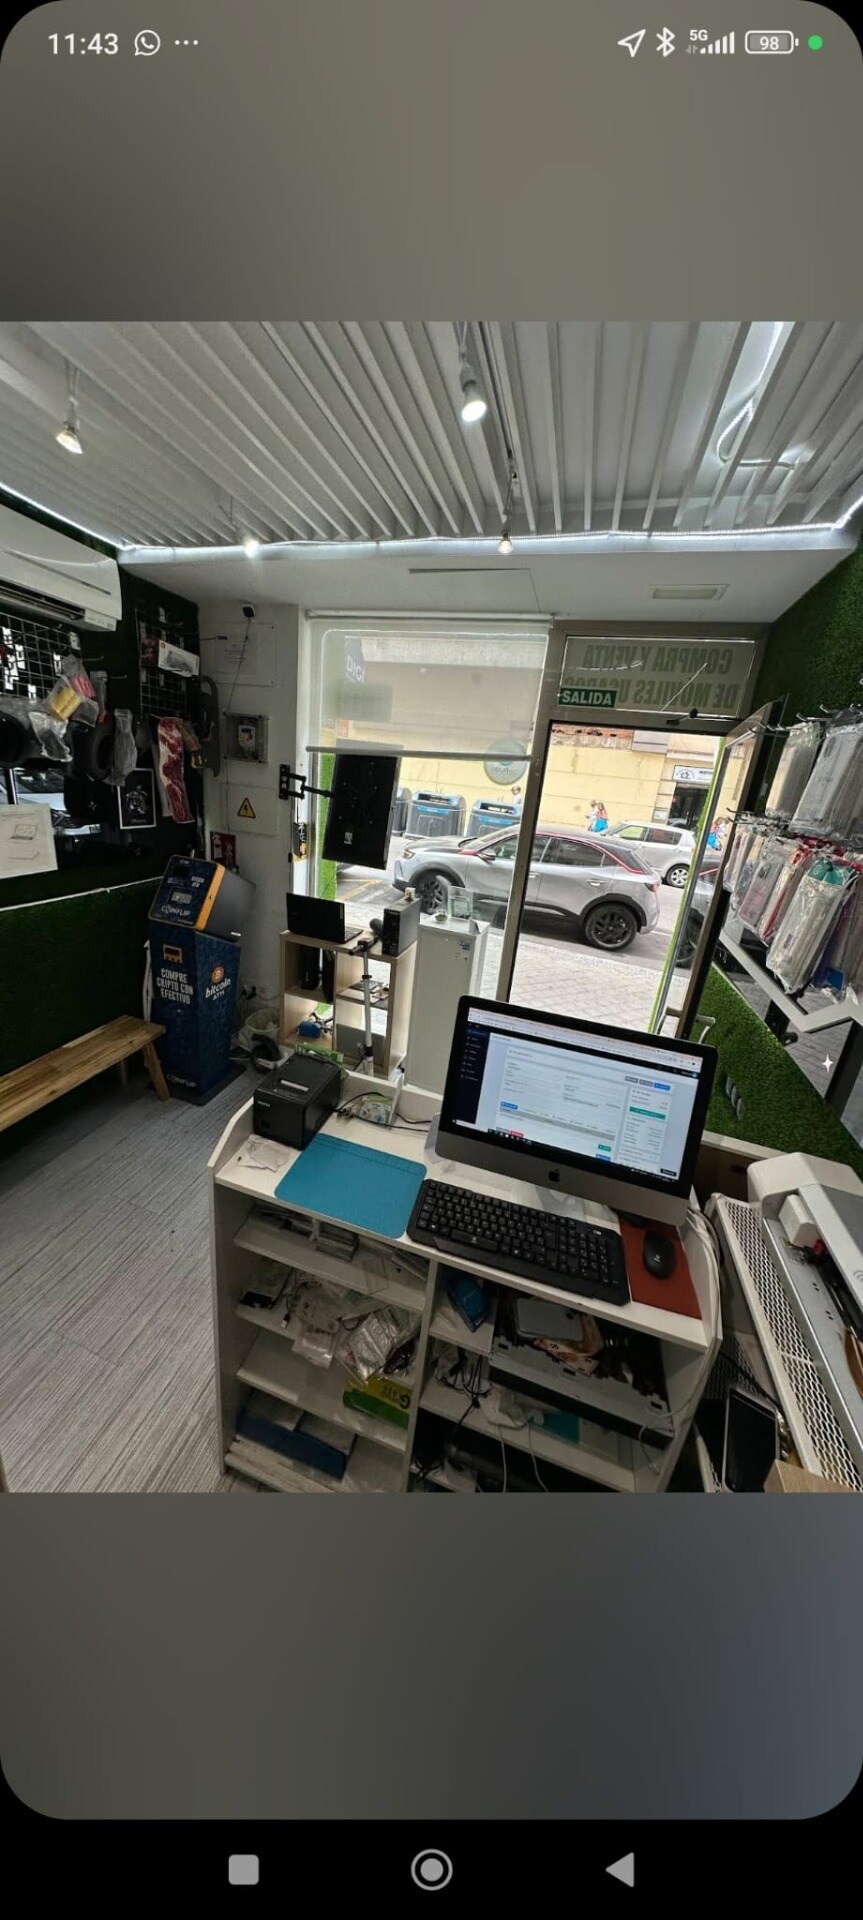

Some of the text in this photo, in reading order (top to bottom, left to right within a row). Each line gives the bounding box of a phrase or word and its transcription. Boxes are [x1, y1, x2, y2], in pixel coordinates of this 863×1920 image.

[561, 690, 612, 706] SALIDA
[160, 968, 188, 983] COMPRE
[156, 977, 194, 996] CRIPTO CON
[204, 977, 231, 999] bitcoin
[160, 987, 191, 1005] EFECTIVO
